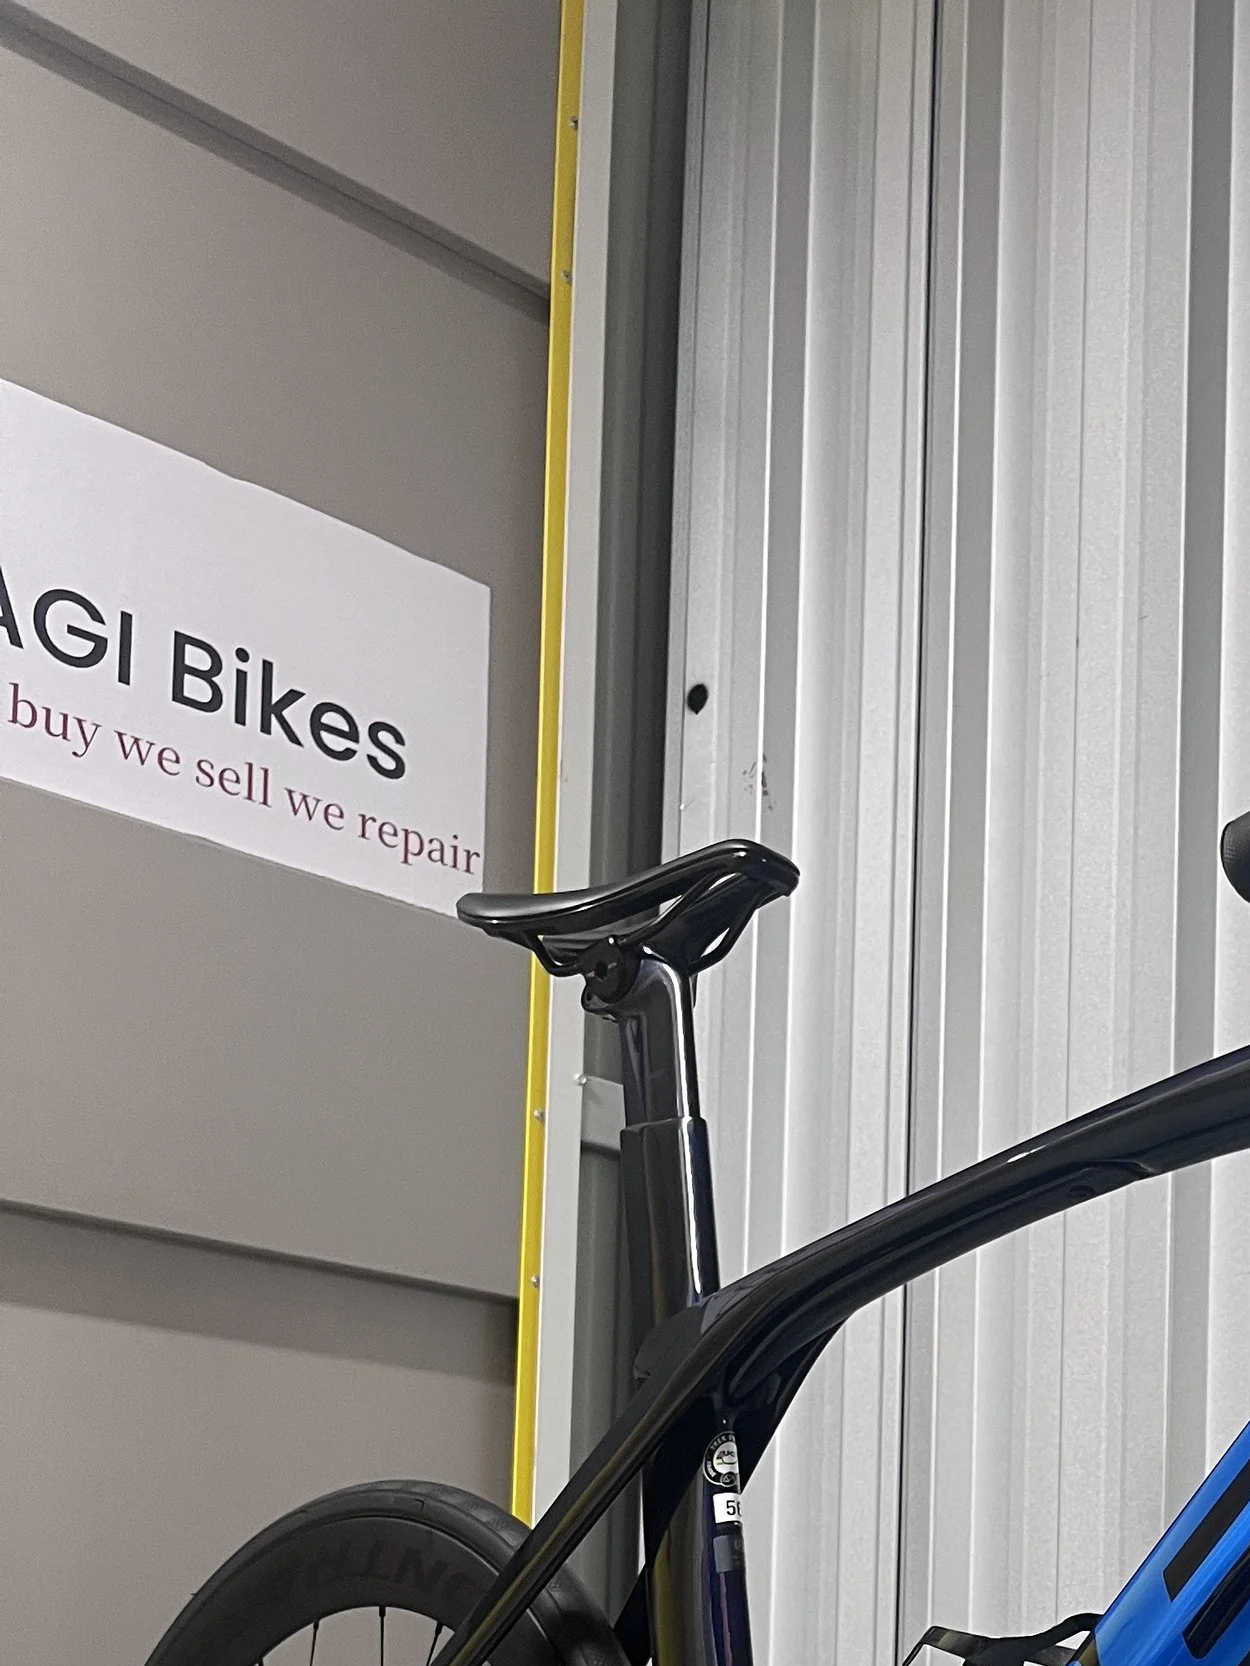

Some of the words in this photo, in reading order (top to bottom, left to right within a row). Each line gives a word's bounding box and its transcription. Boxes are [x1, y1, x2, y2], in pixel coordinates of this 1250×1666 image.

[8, 682, 103, 760] buy
[115, 730, 182, 778] we
[196, 761, 274, 810] sell
[284, 788, 346, 832] we
[358, 814, 481, 876] repair
[171, 630, 407, 781] Bikes
